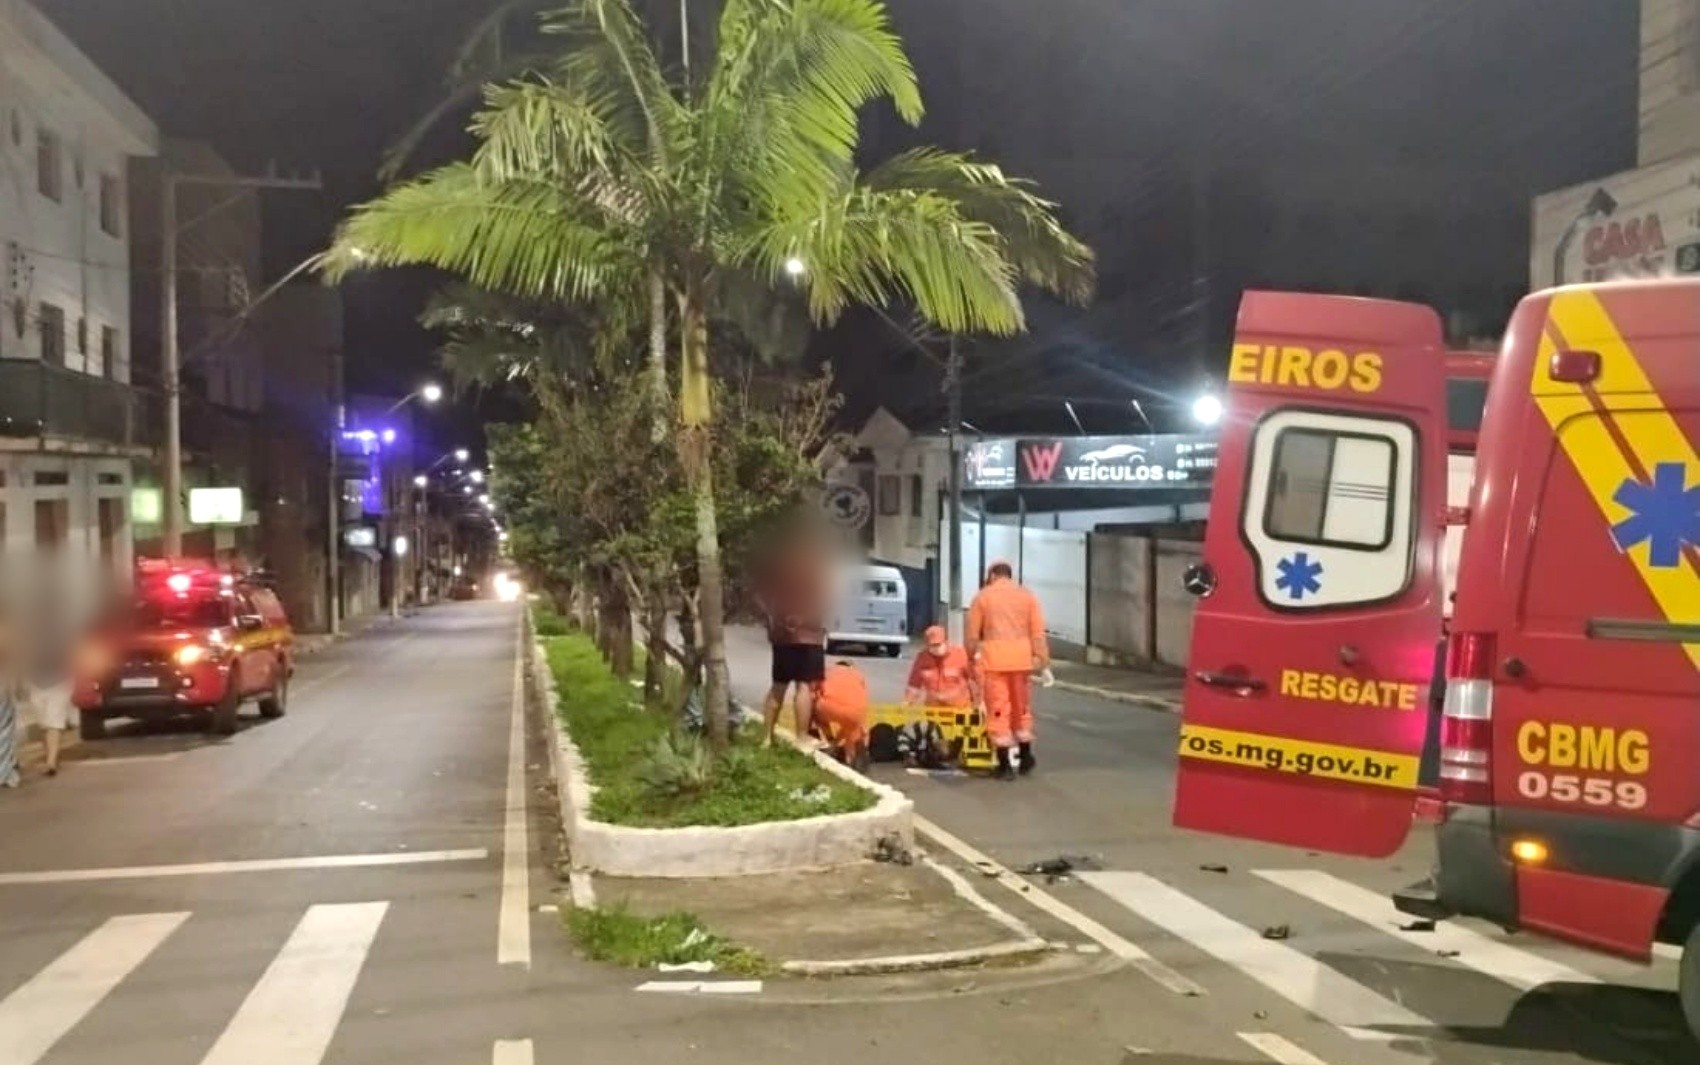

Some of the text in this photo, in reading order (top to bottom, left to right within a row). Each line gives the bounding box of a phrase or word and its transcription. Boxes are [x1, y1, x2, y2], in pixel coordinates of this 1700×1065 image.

[1583, 212, 1665, 266] CASA
[1228, 343, 1383, 393] EIROS
[1065, 460, 1164, 481] VEÍCULOS
[1280, 669, 1418, 711] RESGATE
[1517, 720, 1650, 774] CBMG
[1518, 771, 1647, 810] 0559
